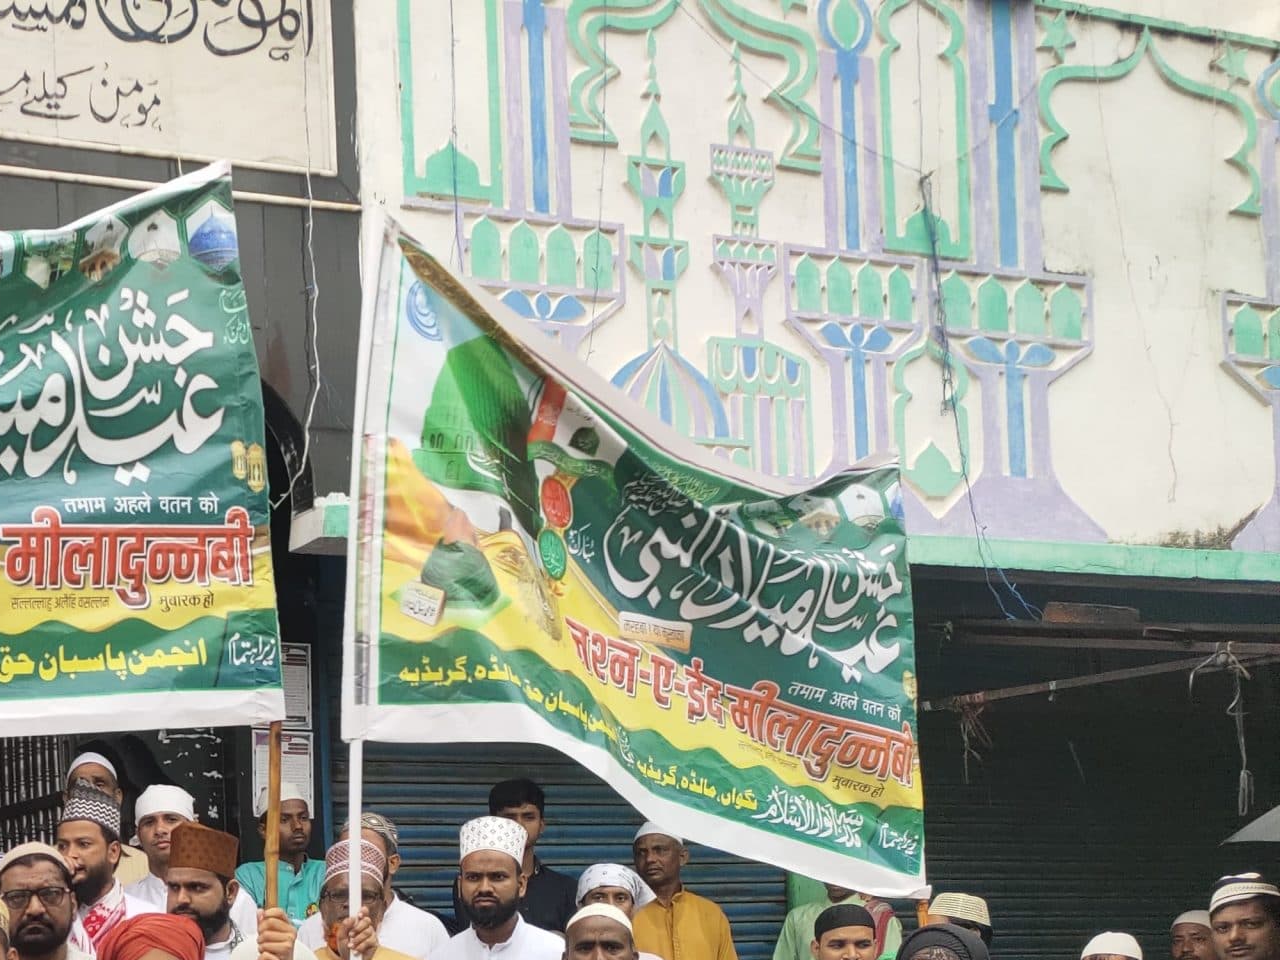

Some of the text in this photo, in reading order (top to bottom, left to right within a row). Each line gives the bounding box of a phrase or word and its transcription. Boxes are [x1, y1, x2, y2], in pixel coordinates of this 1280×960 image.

[63, 492, 220, 515] तमाम अहले वतन को
[0, 505, 256, 609] मीलादुन्नबी
[787, 681, 902, 722] तमाम अहले वतन को
